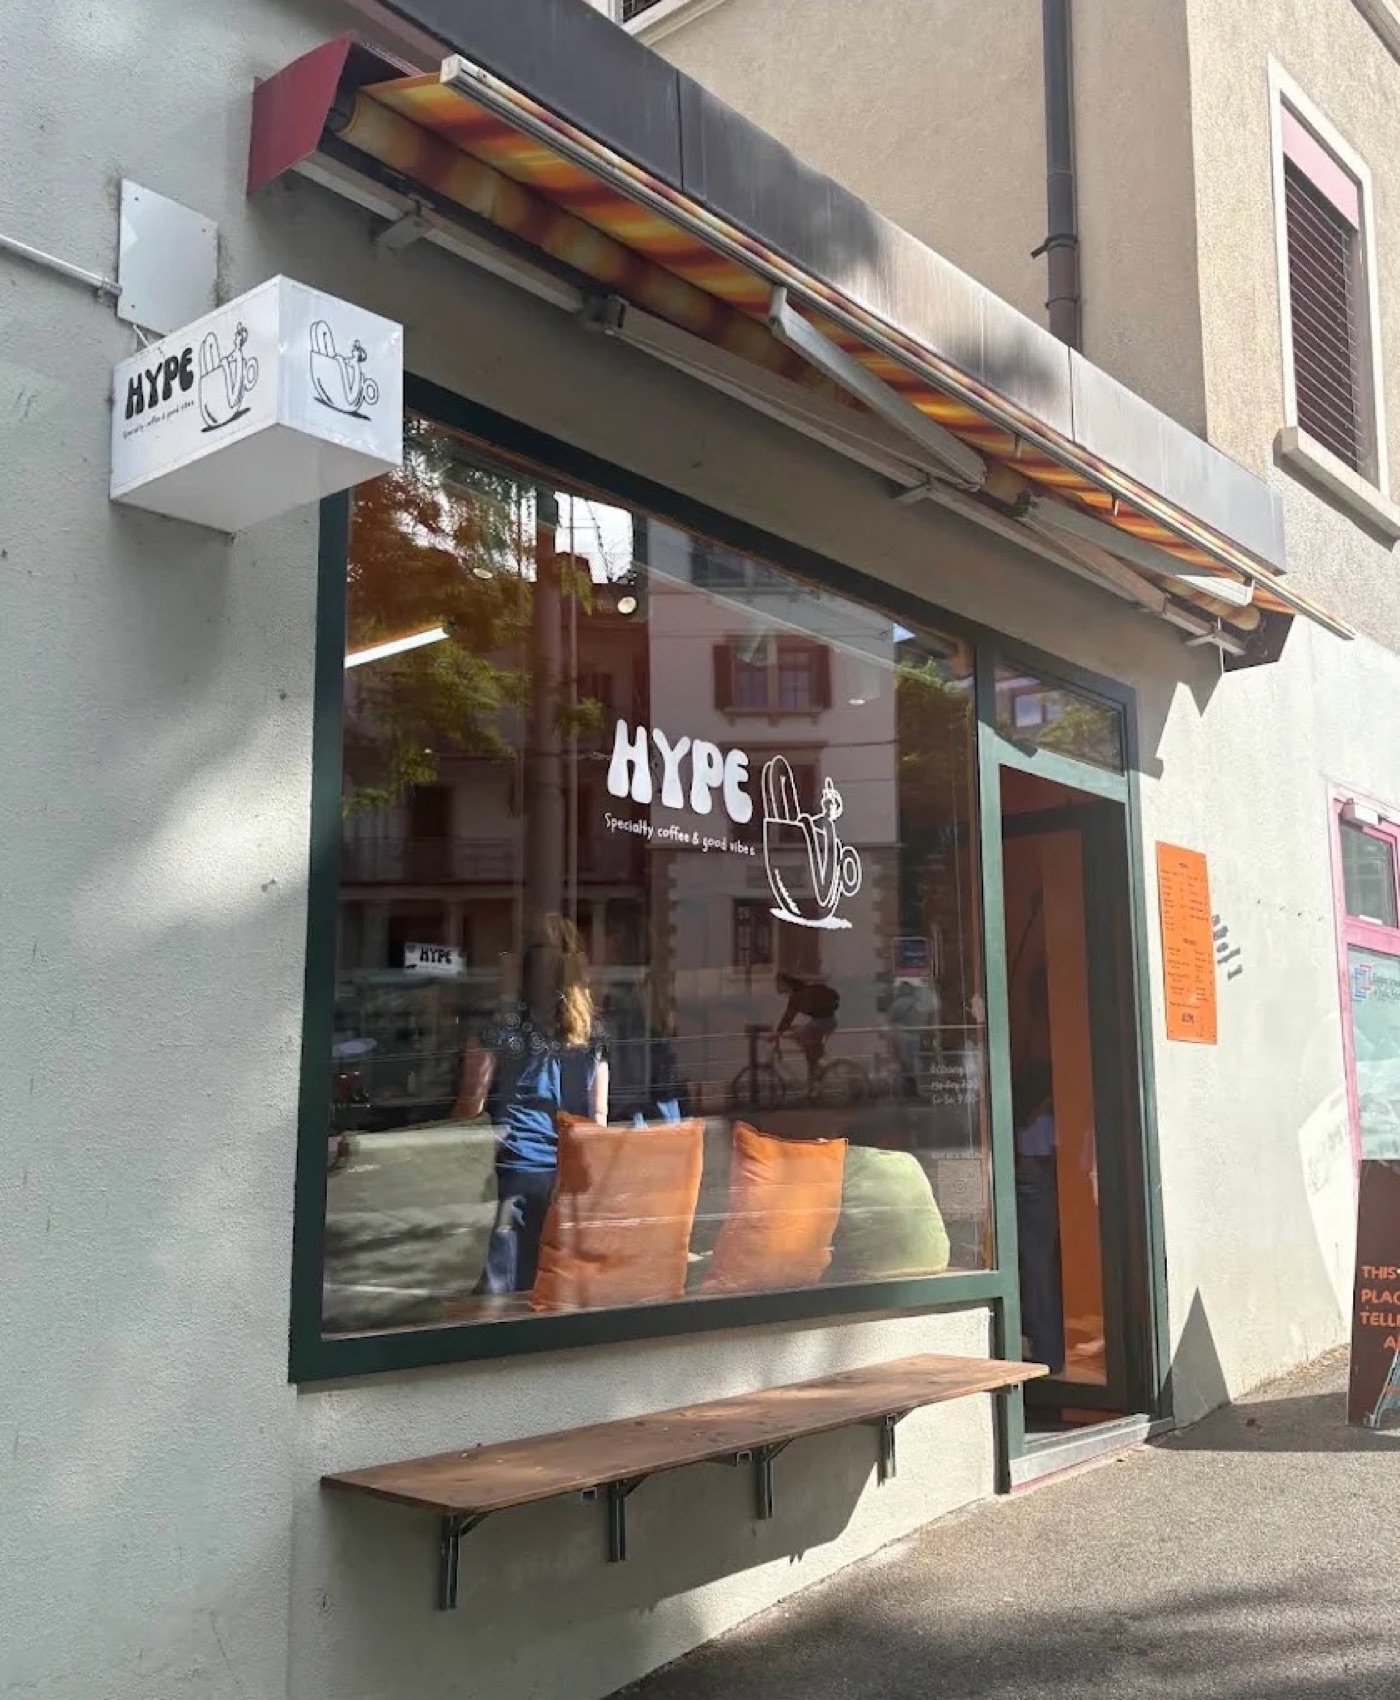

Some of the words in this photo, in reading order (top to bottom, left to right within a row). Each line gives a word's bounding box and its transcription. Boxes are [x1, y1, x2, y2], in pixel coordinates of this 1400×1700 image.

[125, 347, 194, 420] HYPE
[607, 718, 753, 824] HYPE
[603, 812, 654, 840] Specialty
[657, 824, 691, 844] coffee
[691, 831, 699, 844] &
[701, 832, 727, 853] good
[729, 839, 756, 856] vibes
[1360, 1265, 1397, 1279] THIS
